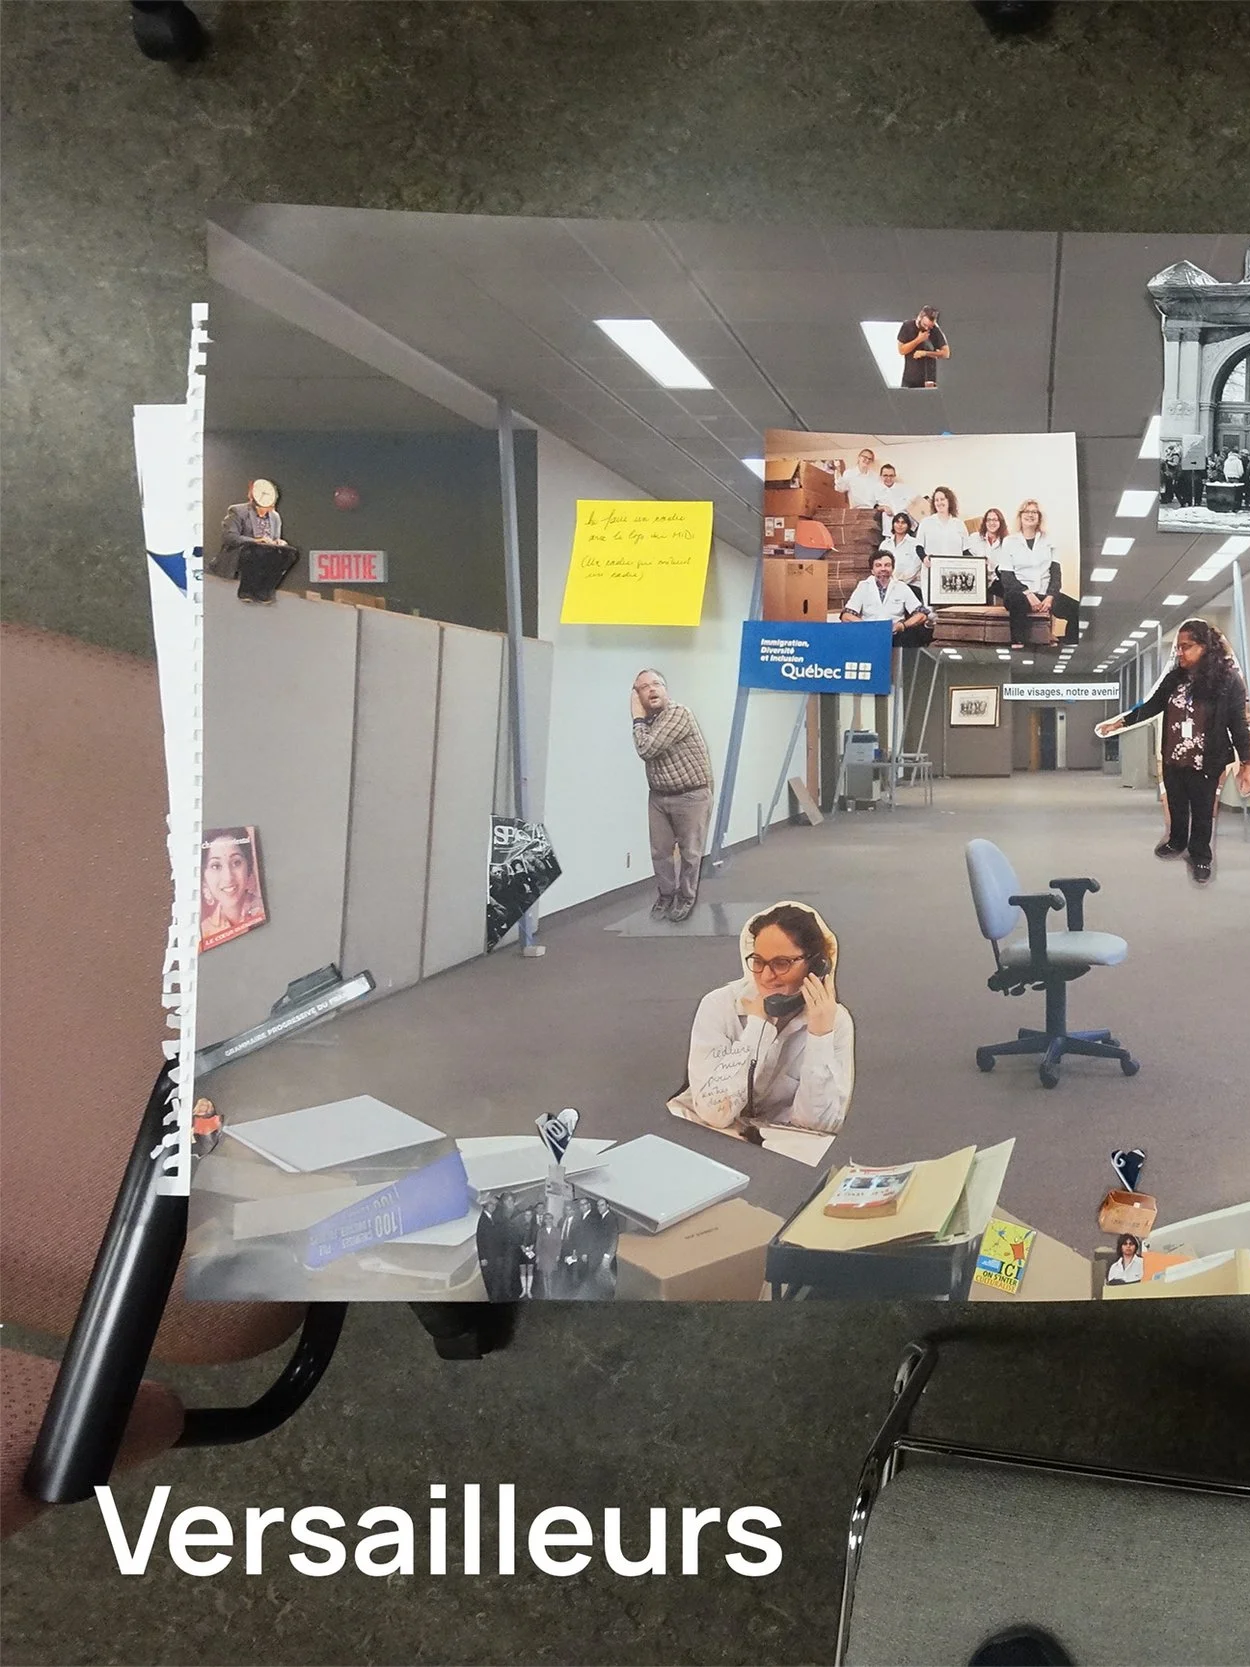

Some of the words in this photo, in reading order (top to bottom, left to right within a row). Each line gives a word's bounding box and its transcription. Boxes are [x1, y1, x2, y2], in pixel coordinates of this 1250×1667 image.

[317, 554, 377, 579] SORTIE
[760, 654, 768, 662] et
[770, 654, 804, 663] Inclusion
[781, 662, 842, 680] Québec
[1004, 687, 1025, 697] Mille
[1027, 687, 1064, 698] visages,
[1066, 687, 1089, 696] notre
[1091, 686, 1119, 697] avenir
[224, 1032, 267, 1057] GRAMMAIRE
[267, 1008, 317, 1036] PROGRESSIVE
[316, 1001, 329, 1012] DU
[982, 1270, 994, 1279] ON
[998, 1261, 1022, 1279] ICI
